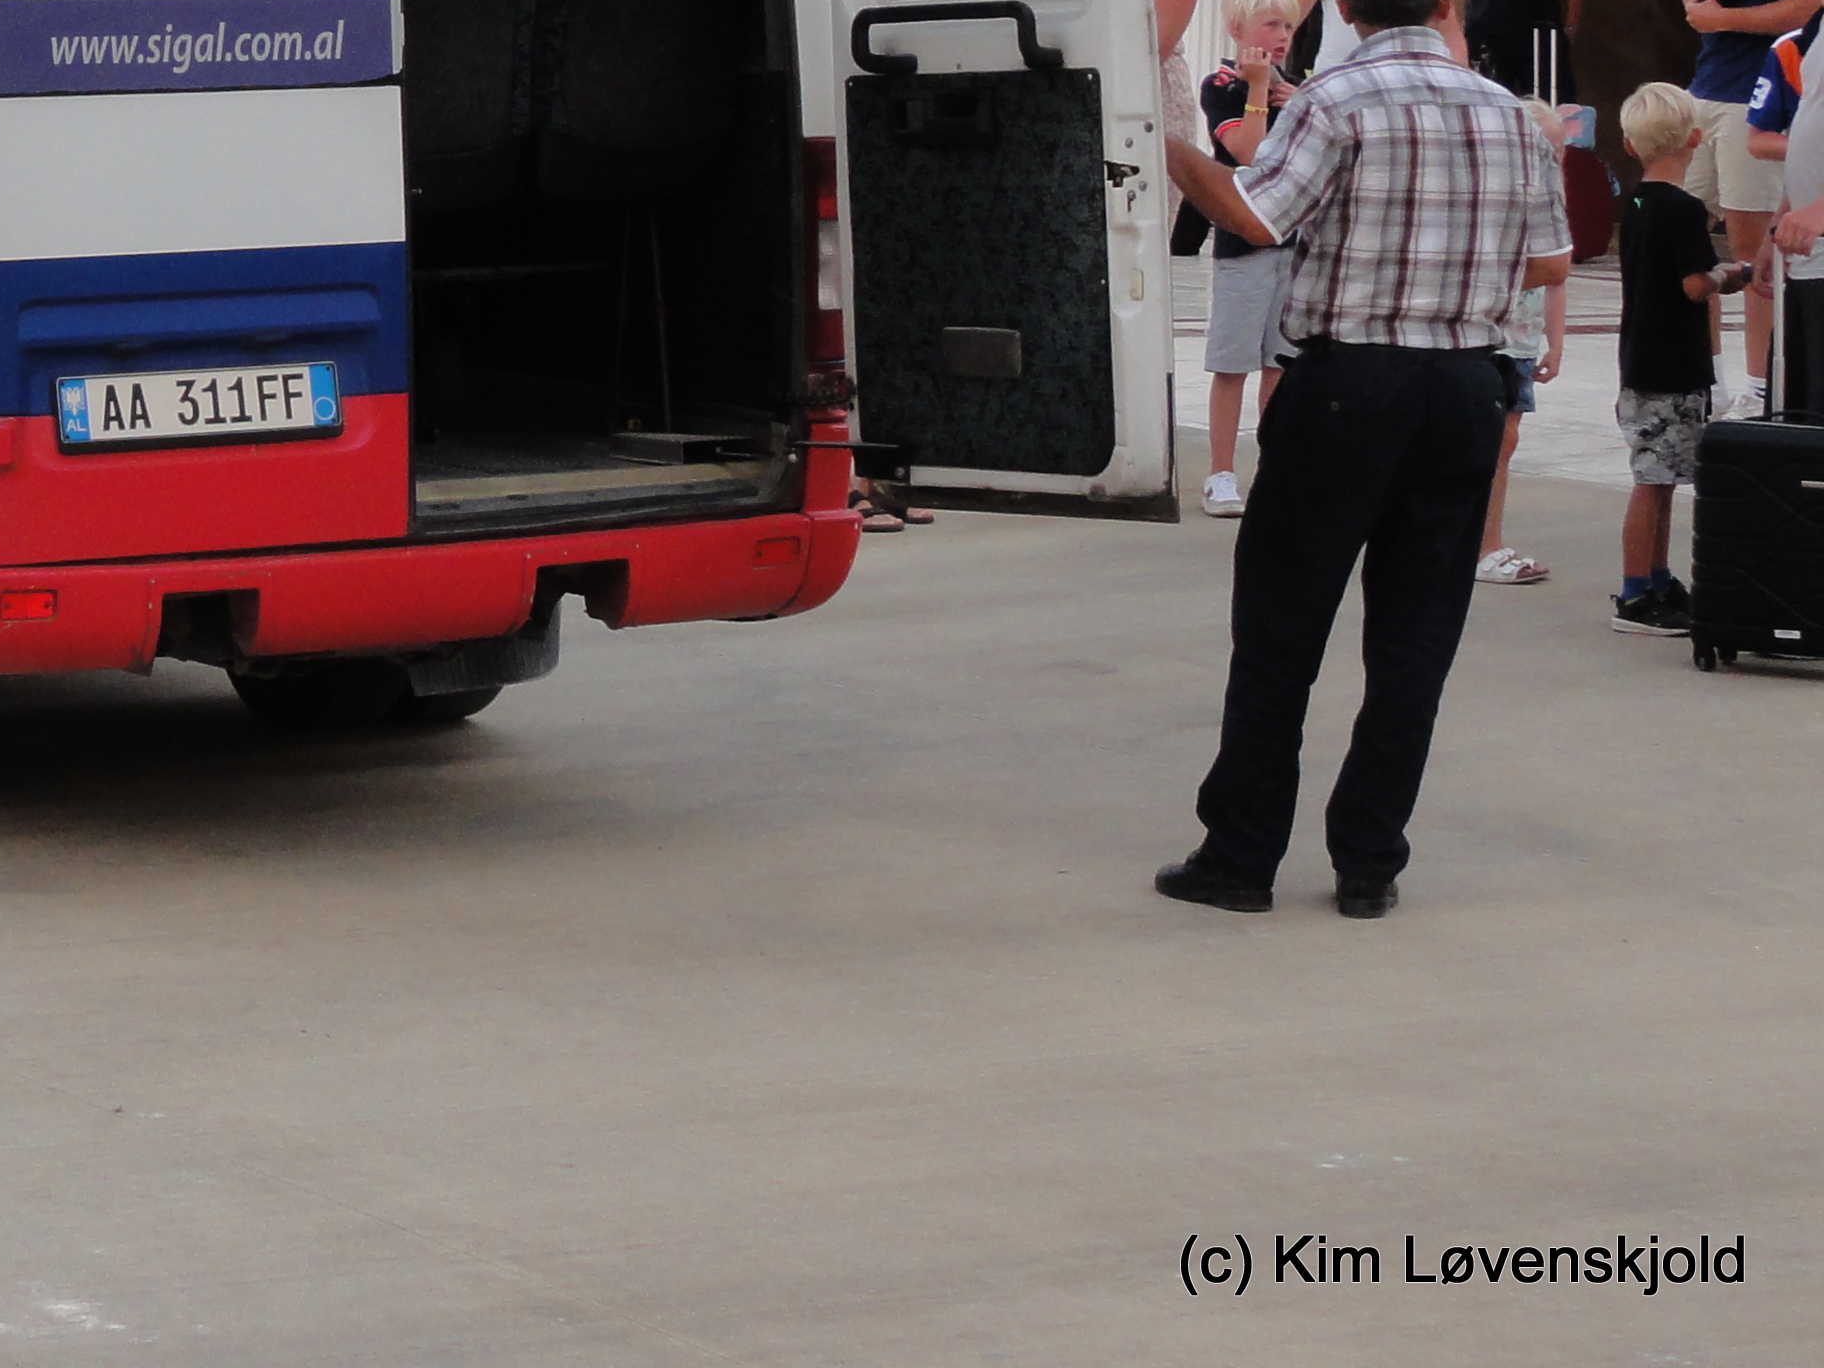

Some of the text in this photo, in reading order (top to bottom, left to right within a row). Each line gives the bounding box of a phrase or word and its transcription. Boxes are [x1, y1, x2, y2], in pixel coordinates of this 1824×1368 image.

[50, 20, 344, 74] www.sigal.com.al
[66, 419, 87, 432] AL
[103, 373, 304, 432] AA 311FF
